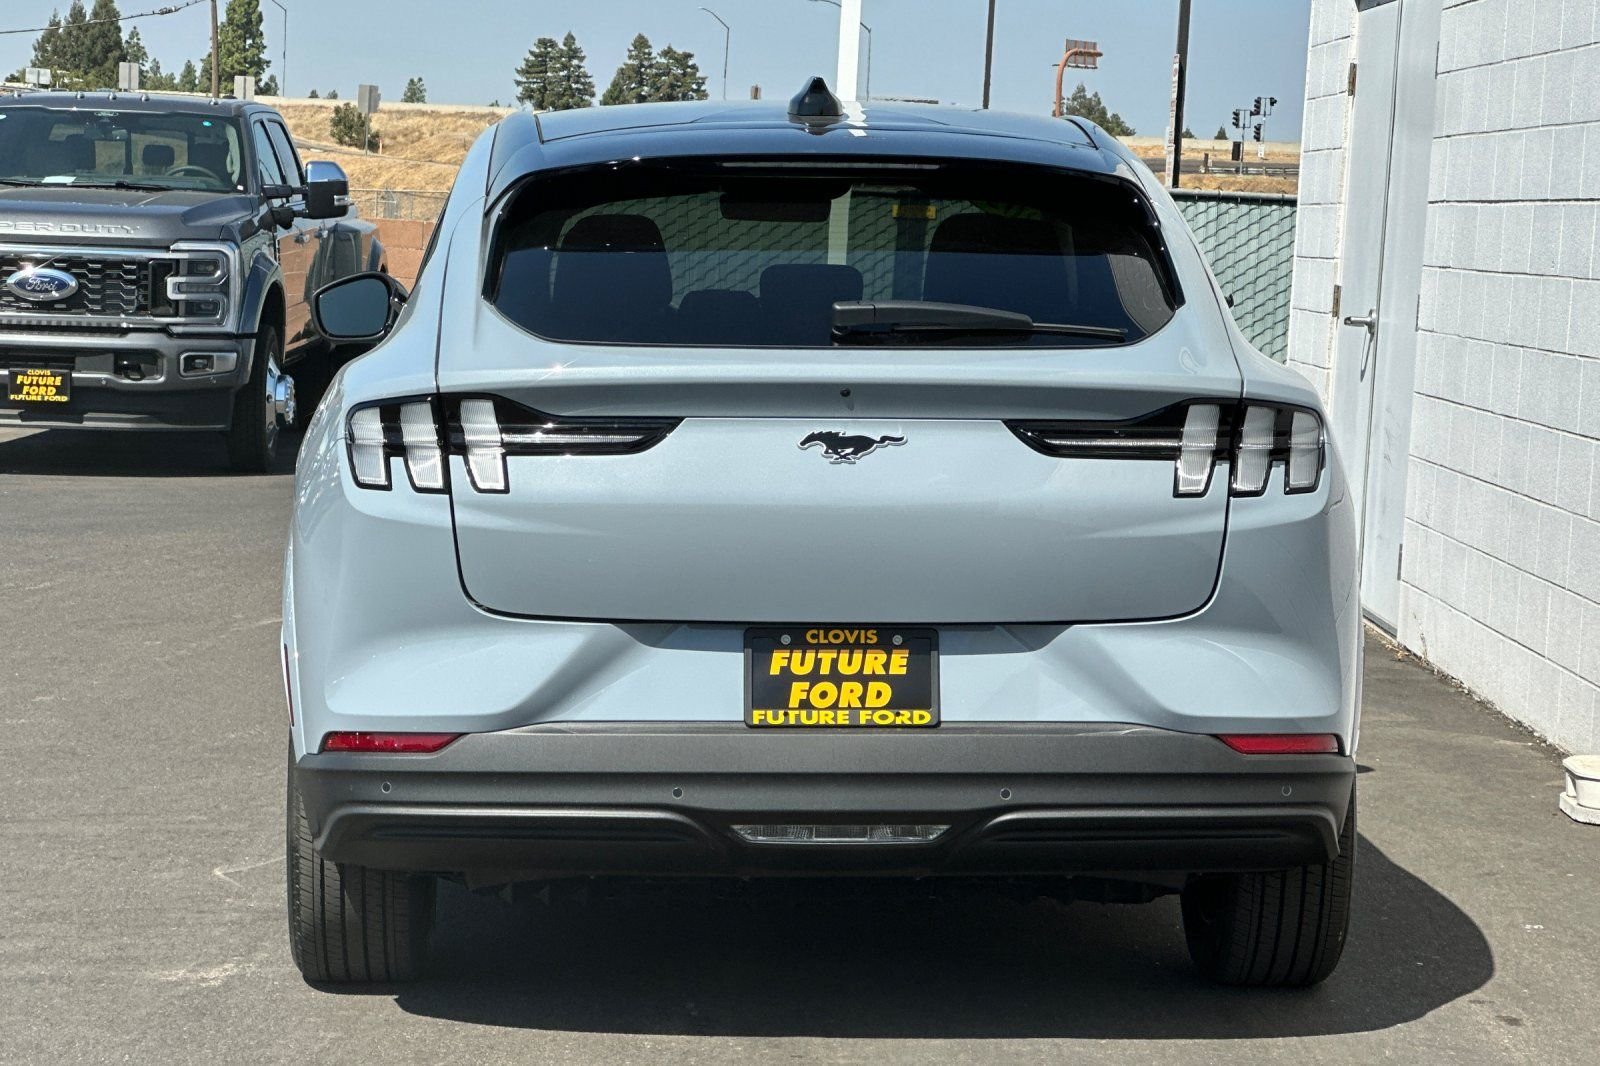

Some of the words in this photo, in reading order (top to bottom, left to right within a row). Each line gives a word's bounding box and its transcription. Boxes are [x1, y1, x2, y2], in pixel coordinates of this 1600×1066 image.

[60, 223, 140, 234] DUTY
[25, 277, 59, 290] Ford
[16, 374, 62, 386] FUTURE
[22, 385, 57, 396] FORD
[805, 629, 879, 644] CLOVIS
[769, 649, 910, 676] FUTURE
[788, 681, 893, 709] FORD
[752, 709, 850, 725] FUTURE
[859, 709, 932, 725] FORD
